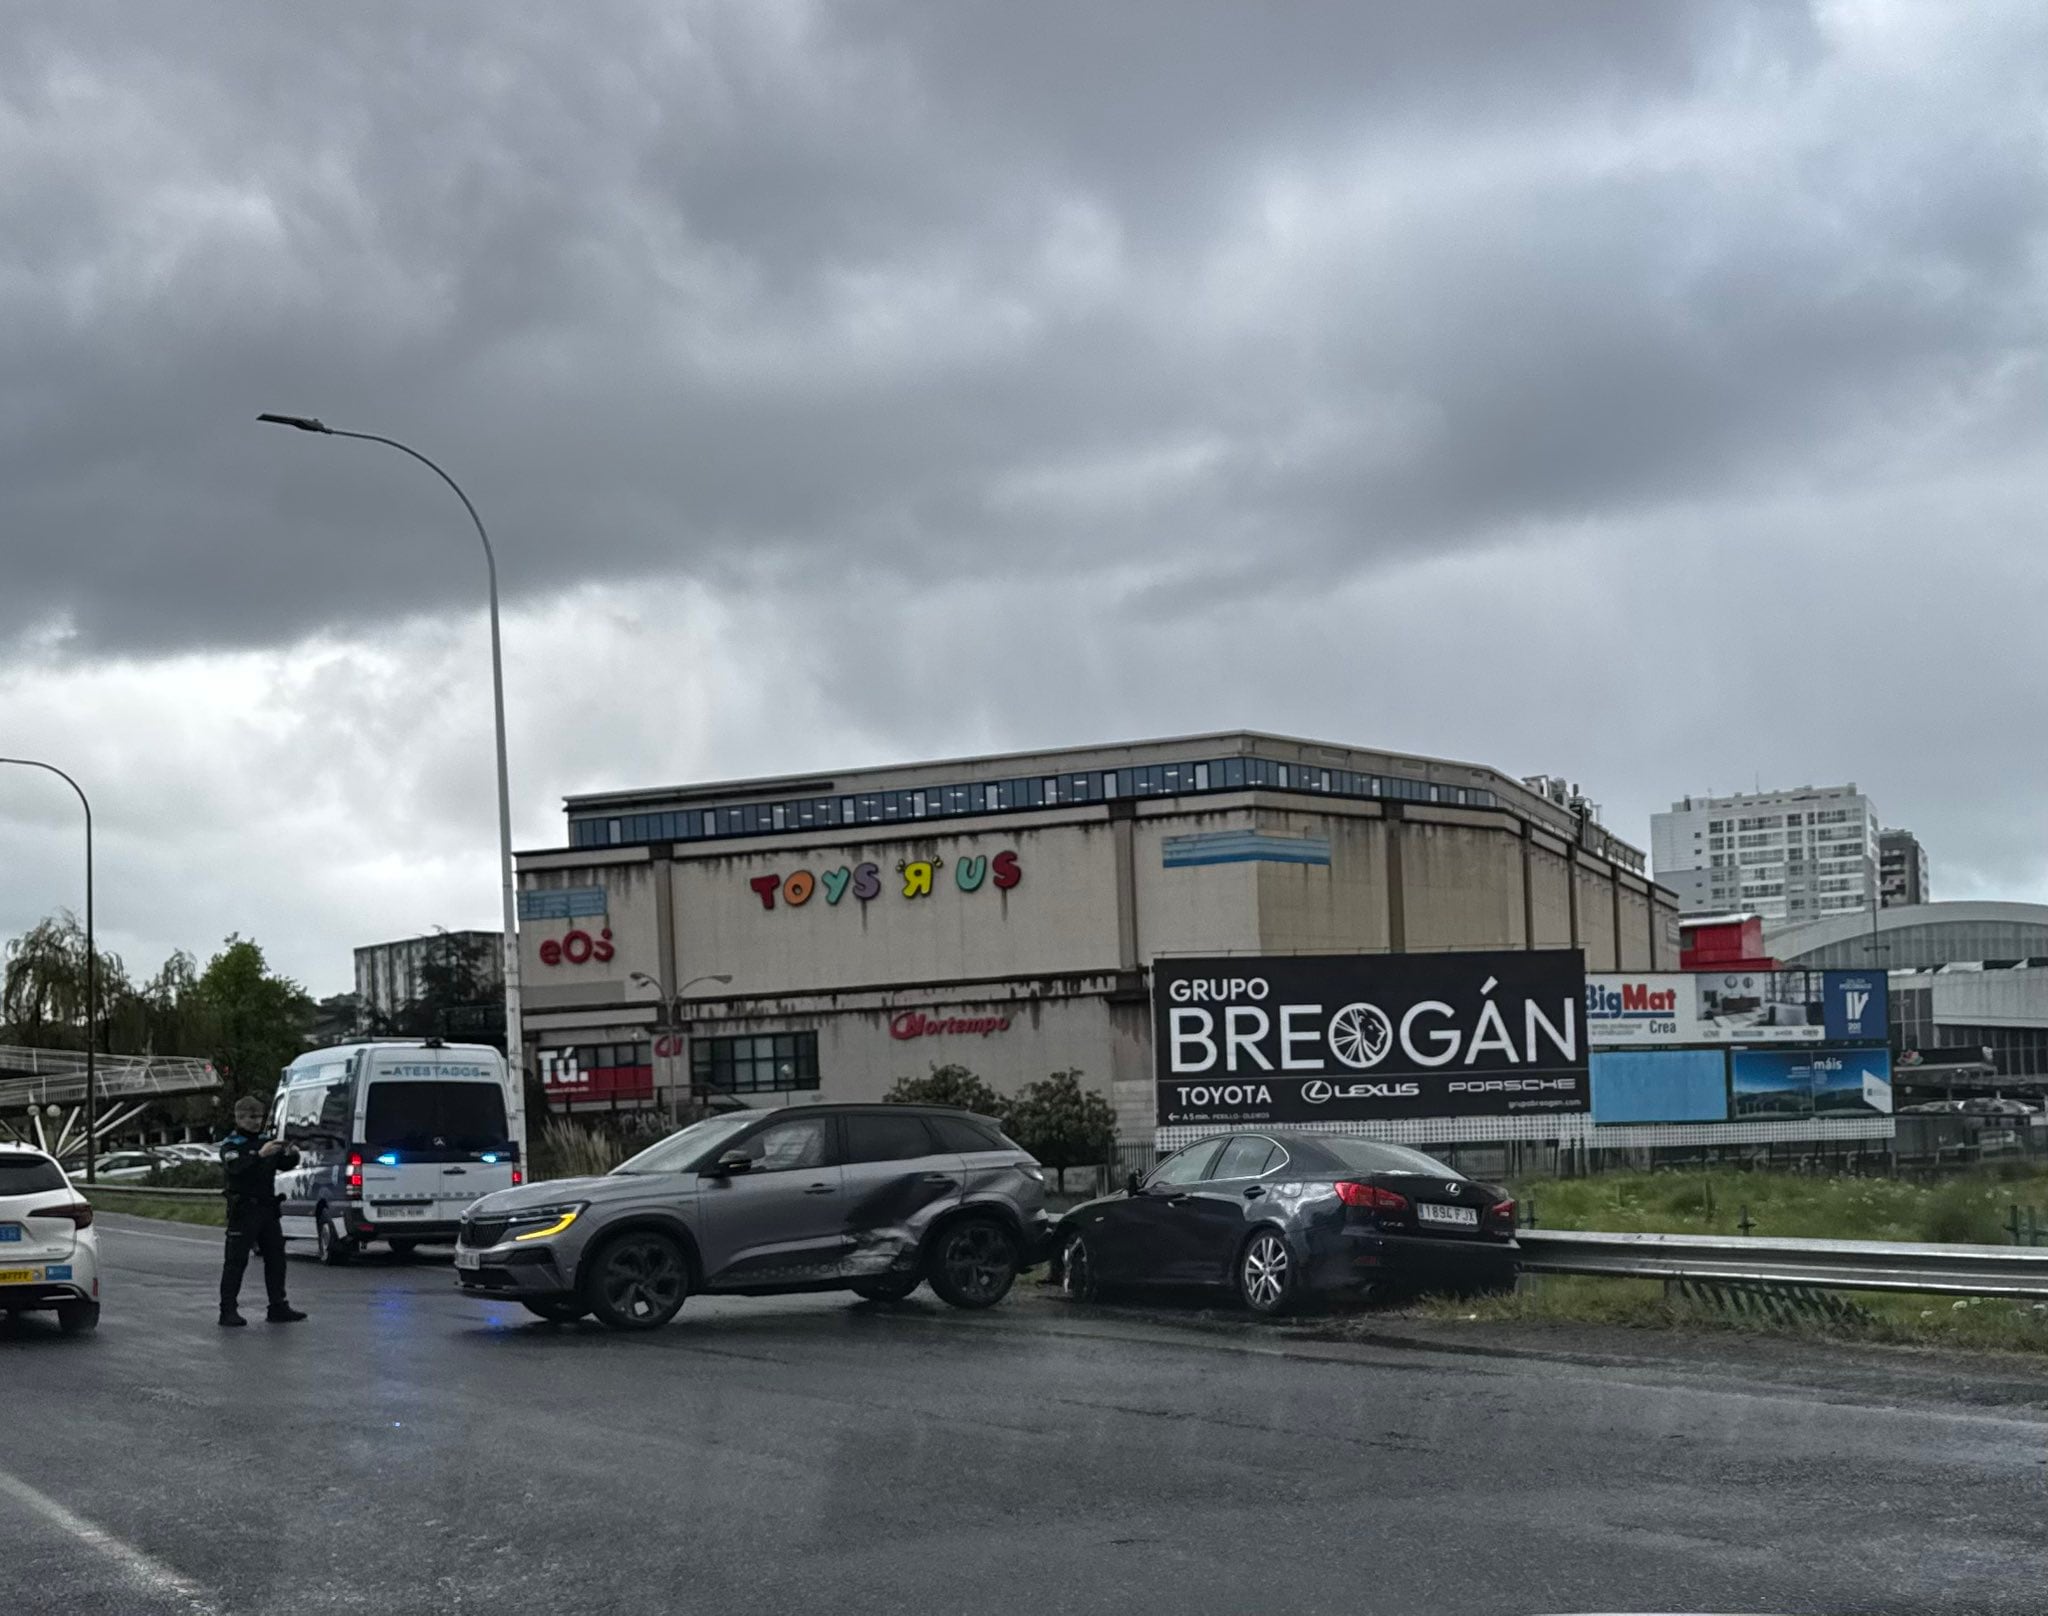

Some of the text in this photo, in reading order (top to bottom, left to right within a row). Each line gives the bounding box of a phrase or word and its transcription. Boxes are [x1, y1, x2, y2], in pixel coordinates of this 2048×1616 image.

[750, 862, 881, 910] TOYS
[955, 850, 1022, 892] US
[1169, 977, 1269, 1002] GRUPO
[1586, 983, 1676, 1019] BigMat
[889, 1011, 1011, 1040] Nortempo
[1169, 976, 1577, 1073] BREOGÁN
[1649, 1020, 1676, 1034] Crea
[1814, 1057, 1842, 1070] máis
[1176, 1085, 1272, 1106] TOYOTA
[1334, 1083, 1420, 1097] LEXUS
[1448, 1078, 1576, 1093] PORSCHE
